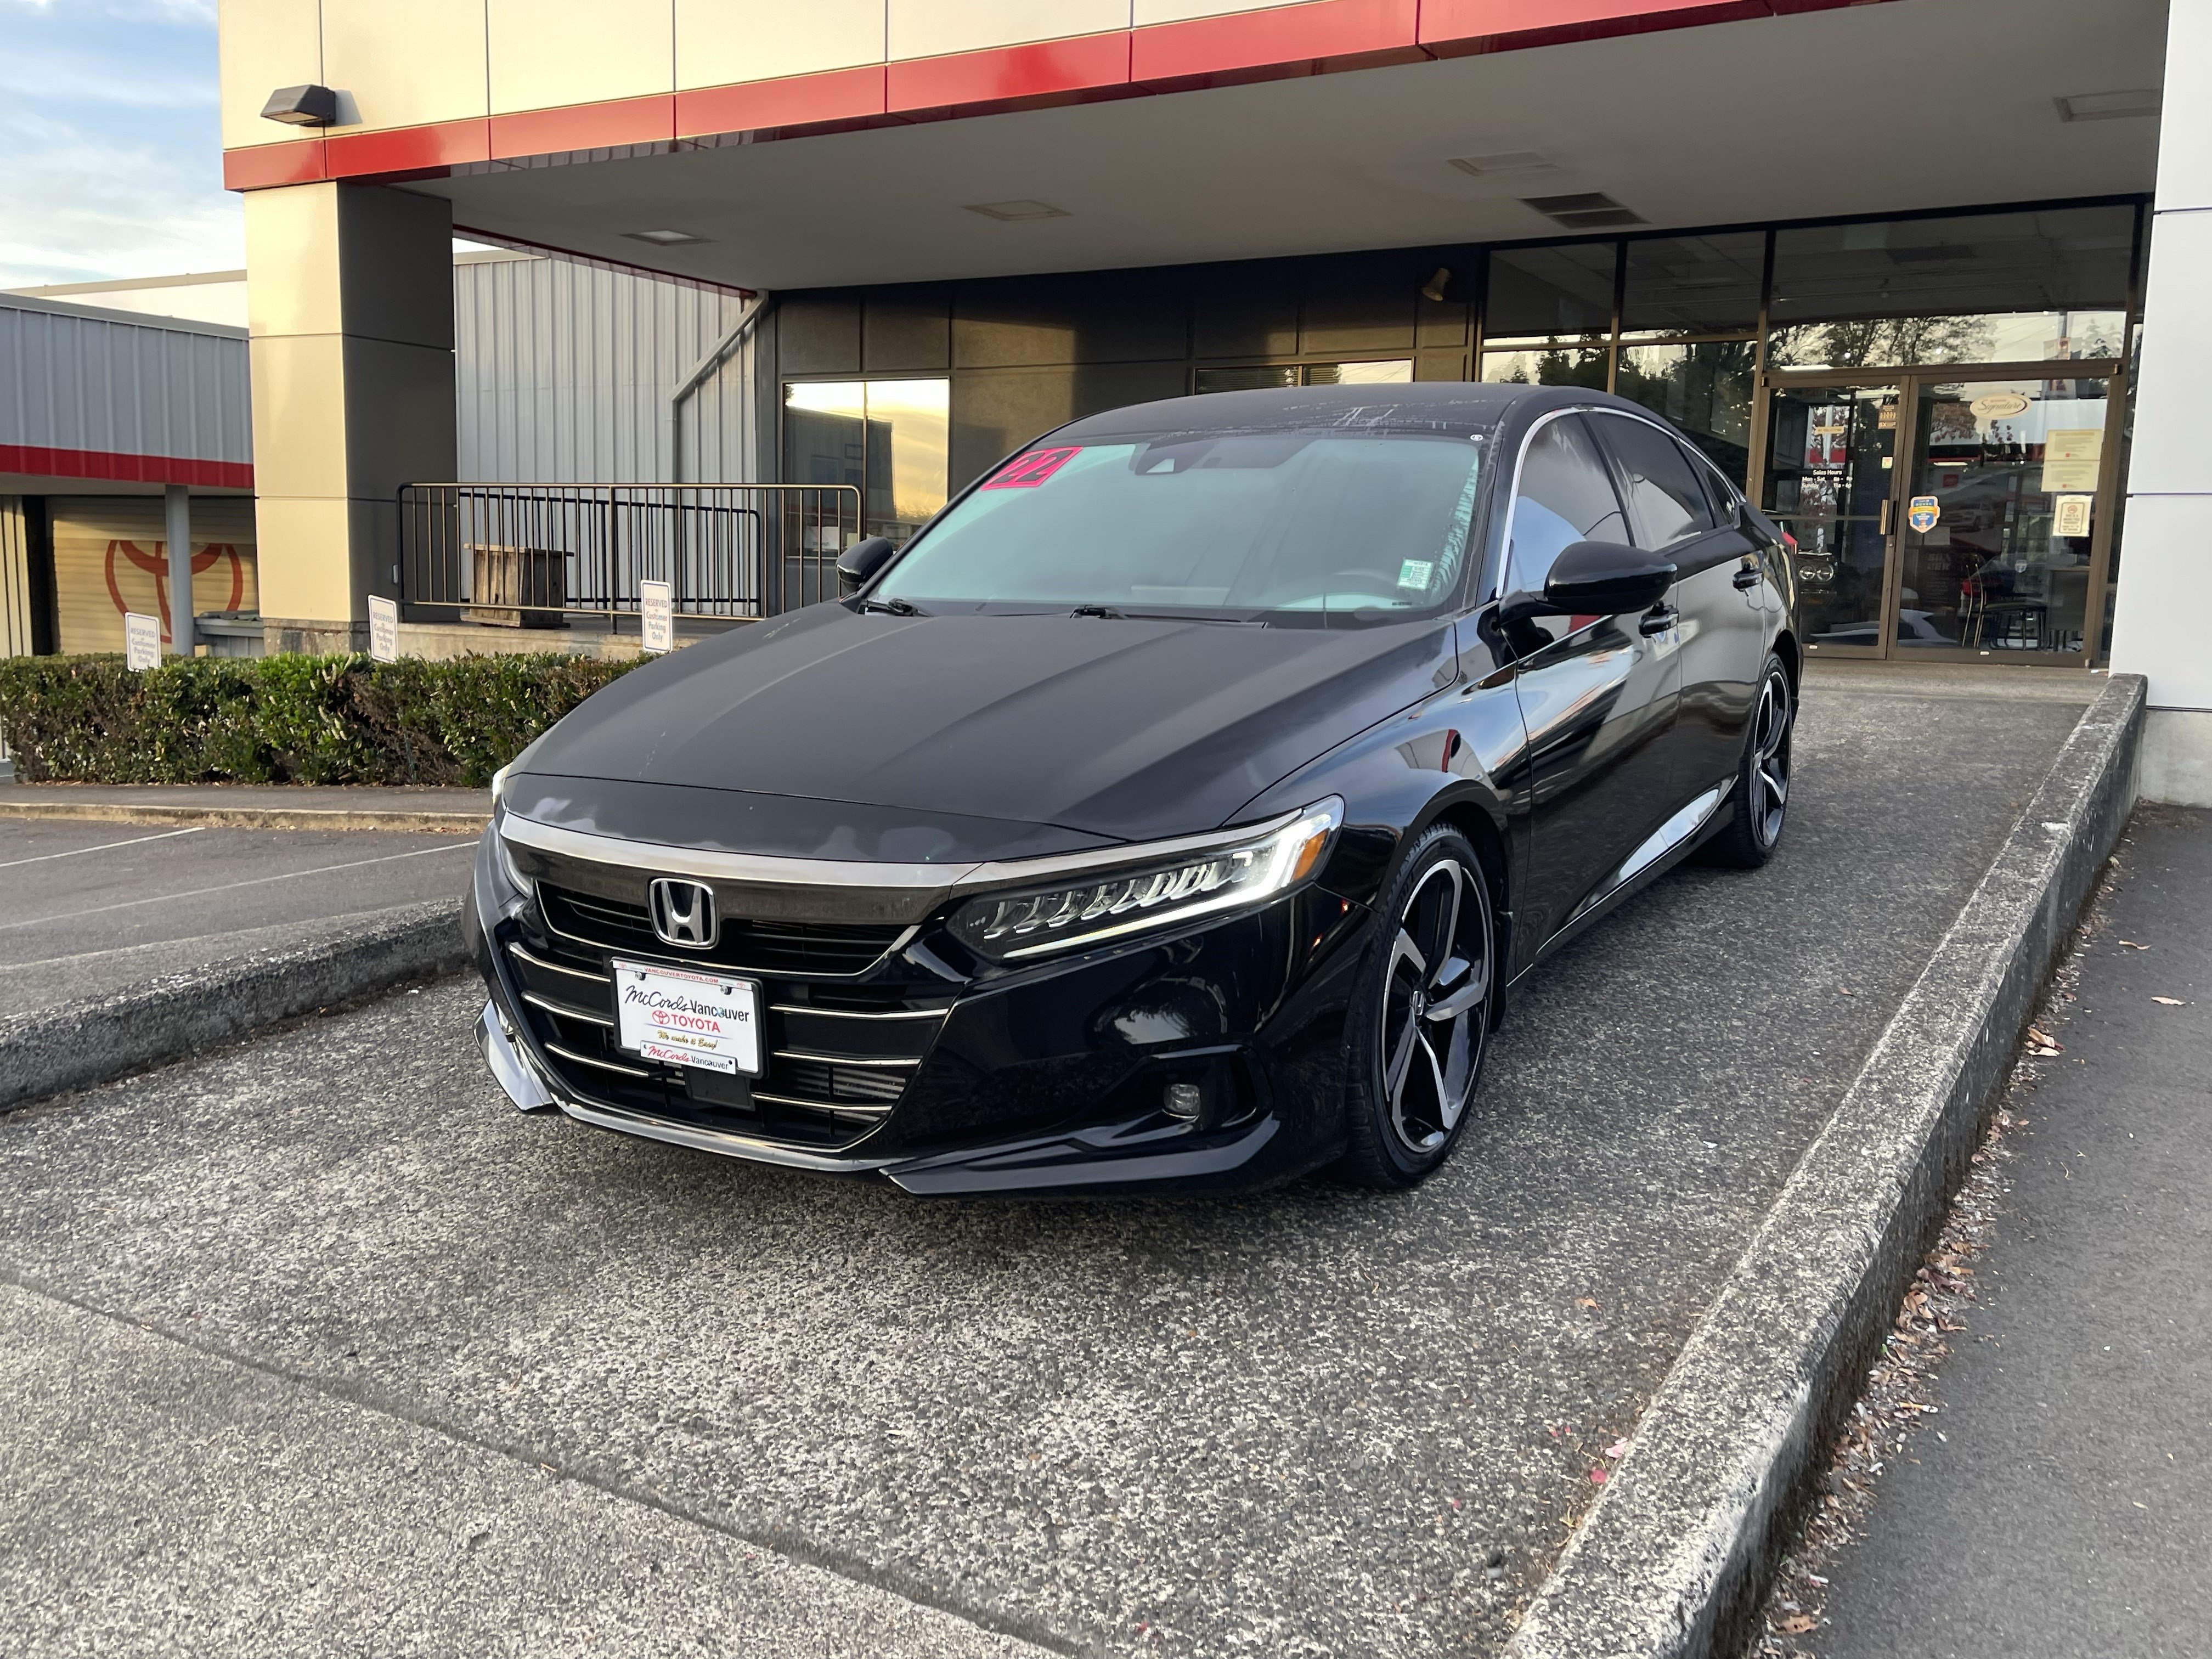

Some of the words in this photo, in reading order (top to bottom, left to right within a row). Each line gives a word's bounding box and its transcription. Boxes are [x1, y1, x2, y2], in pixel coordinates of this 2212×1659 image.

[1978, 399, 2022, 414] Signature
[989, 449, 1074, 485] 22
[645, 597, 668, 608] RESERVED
[373, 612, 393, 624] RESERVED
[646, 611, 668, 622] Customer
[130, 628, 155, 637] RESERVED
[374, 623, 394, 635] Customer
[648, 621, 666, 634] Parking
[132, 637, 156, 648] Customer
[376, 633, 393, 646] Parking
[652, 631, 663, 642] Only
[134, 647, 154, 658] Parking
[380, 642, 390, 654] Only
[644, 967, 719, 984] VANCOUVERTOYOTA.COM
[671, 1014, 721, 1033] TOYOTA
